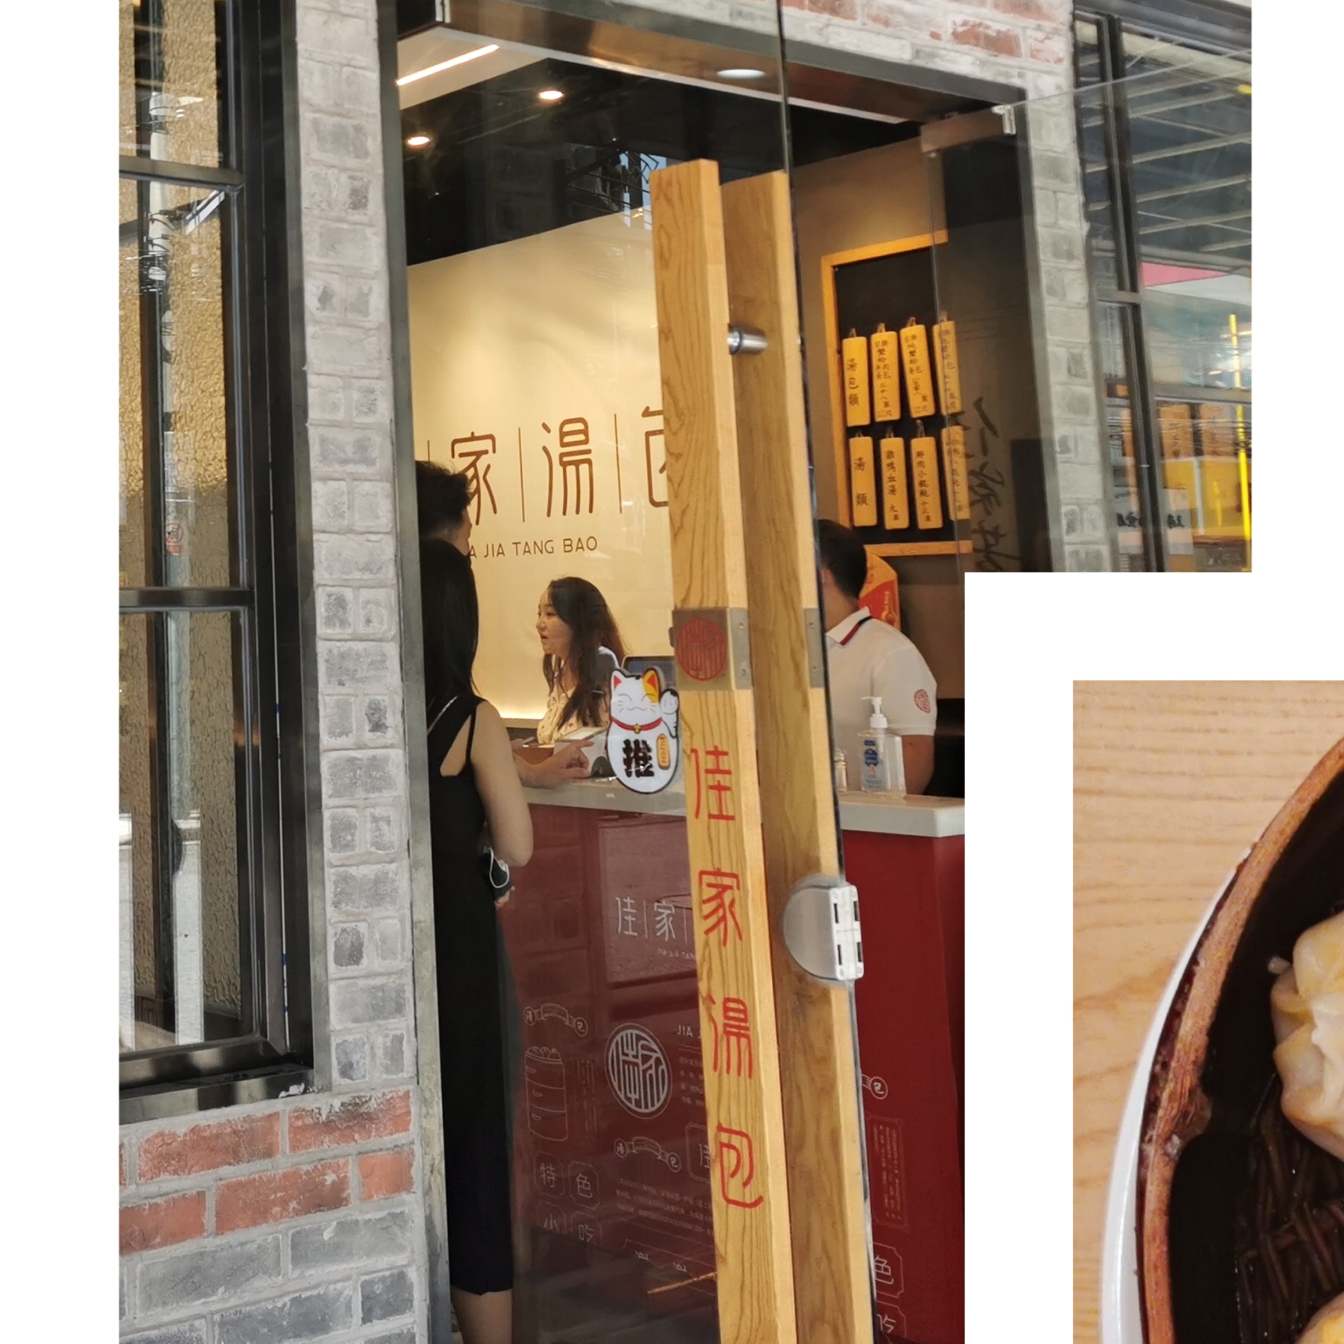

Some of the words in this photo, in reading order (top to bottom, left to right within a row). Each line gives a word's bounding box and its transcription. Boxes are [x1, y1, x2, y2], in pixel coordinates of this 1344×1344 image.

[483, 542, 505, 558] JIA
[511, 538, 555, 555] TANG
[562, 535, 598, 553] BAO
[622, 739, 655, 778] 推
[690, 746, 763, 1209] 佳家湯包
